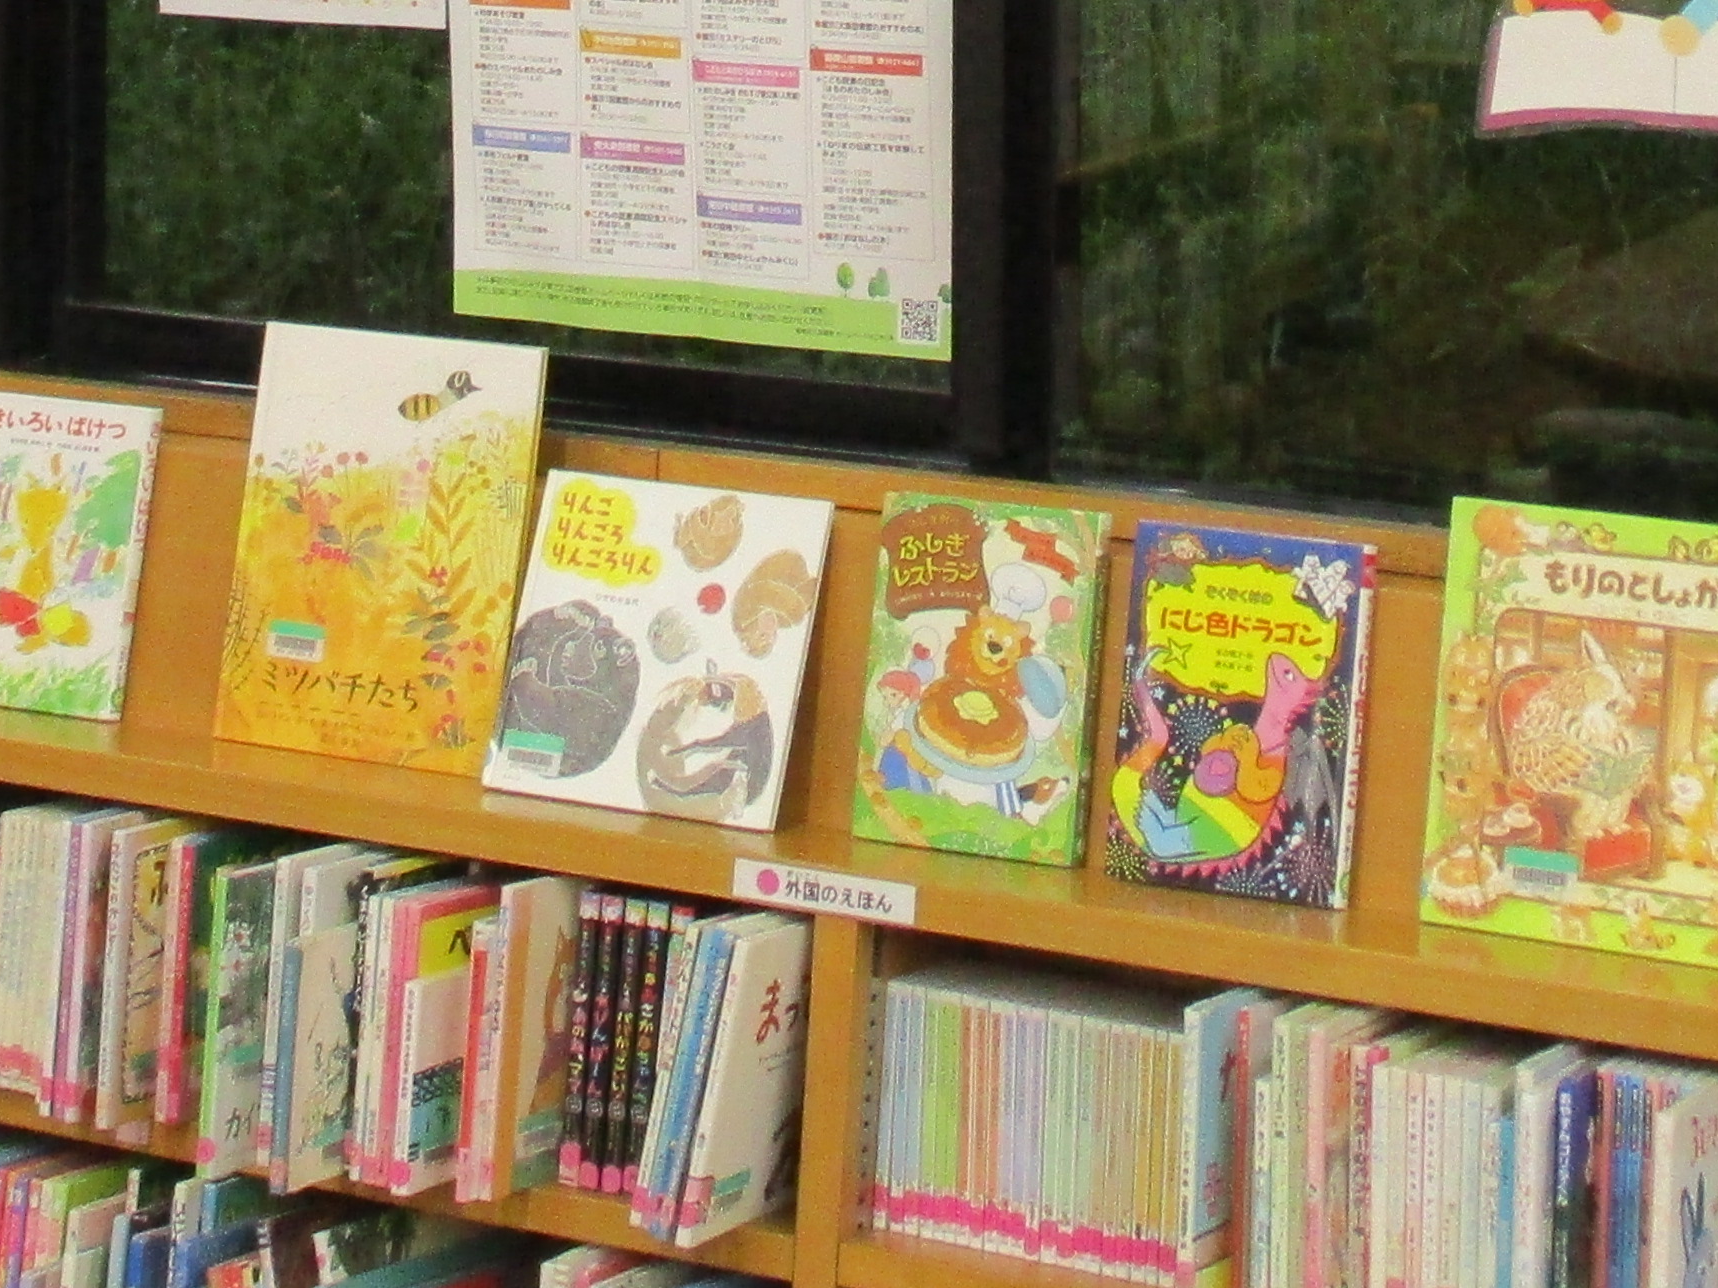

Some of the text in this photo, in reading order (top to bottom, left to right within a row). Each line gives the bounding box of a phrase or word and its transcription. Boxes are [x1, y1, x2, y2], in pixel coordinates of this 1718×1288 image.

[562, 489, 613, 518] りんご
[556, 516, 624, 545] りんごろ
[899, 531, 970, 561] ふしぎ
[551, 544, 654, 577] りんごろりん
[892, 556, 980, 588] レストラン
[1159, 608, 1323, 649] にじ色ドラゴン
[258, 663, 421, 714] ミツバチたち
[785, 879, 893, 914] 外国のえほん
